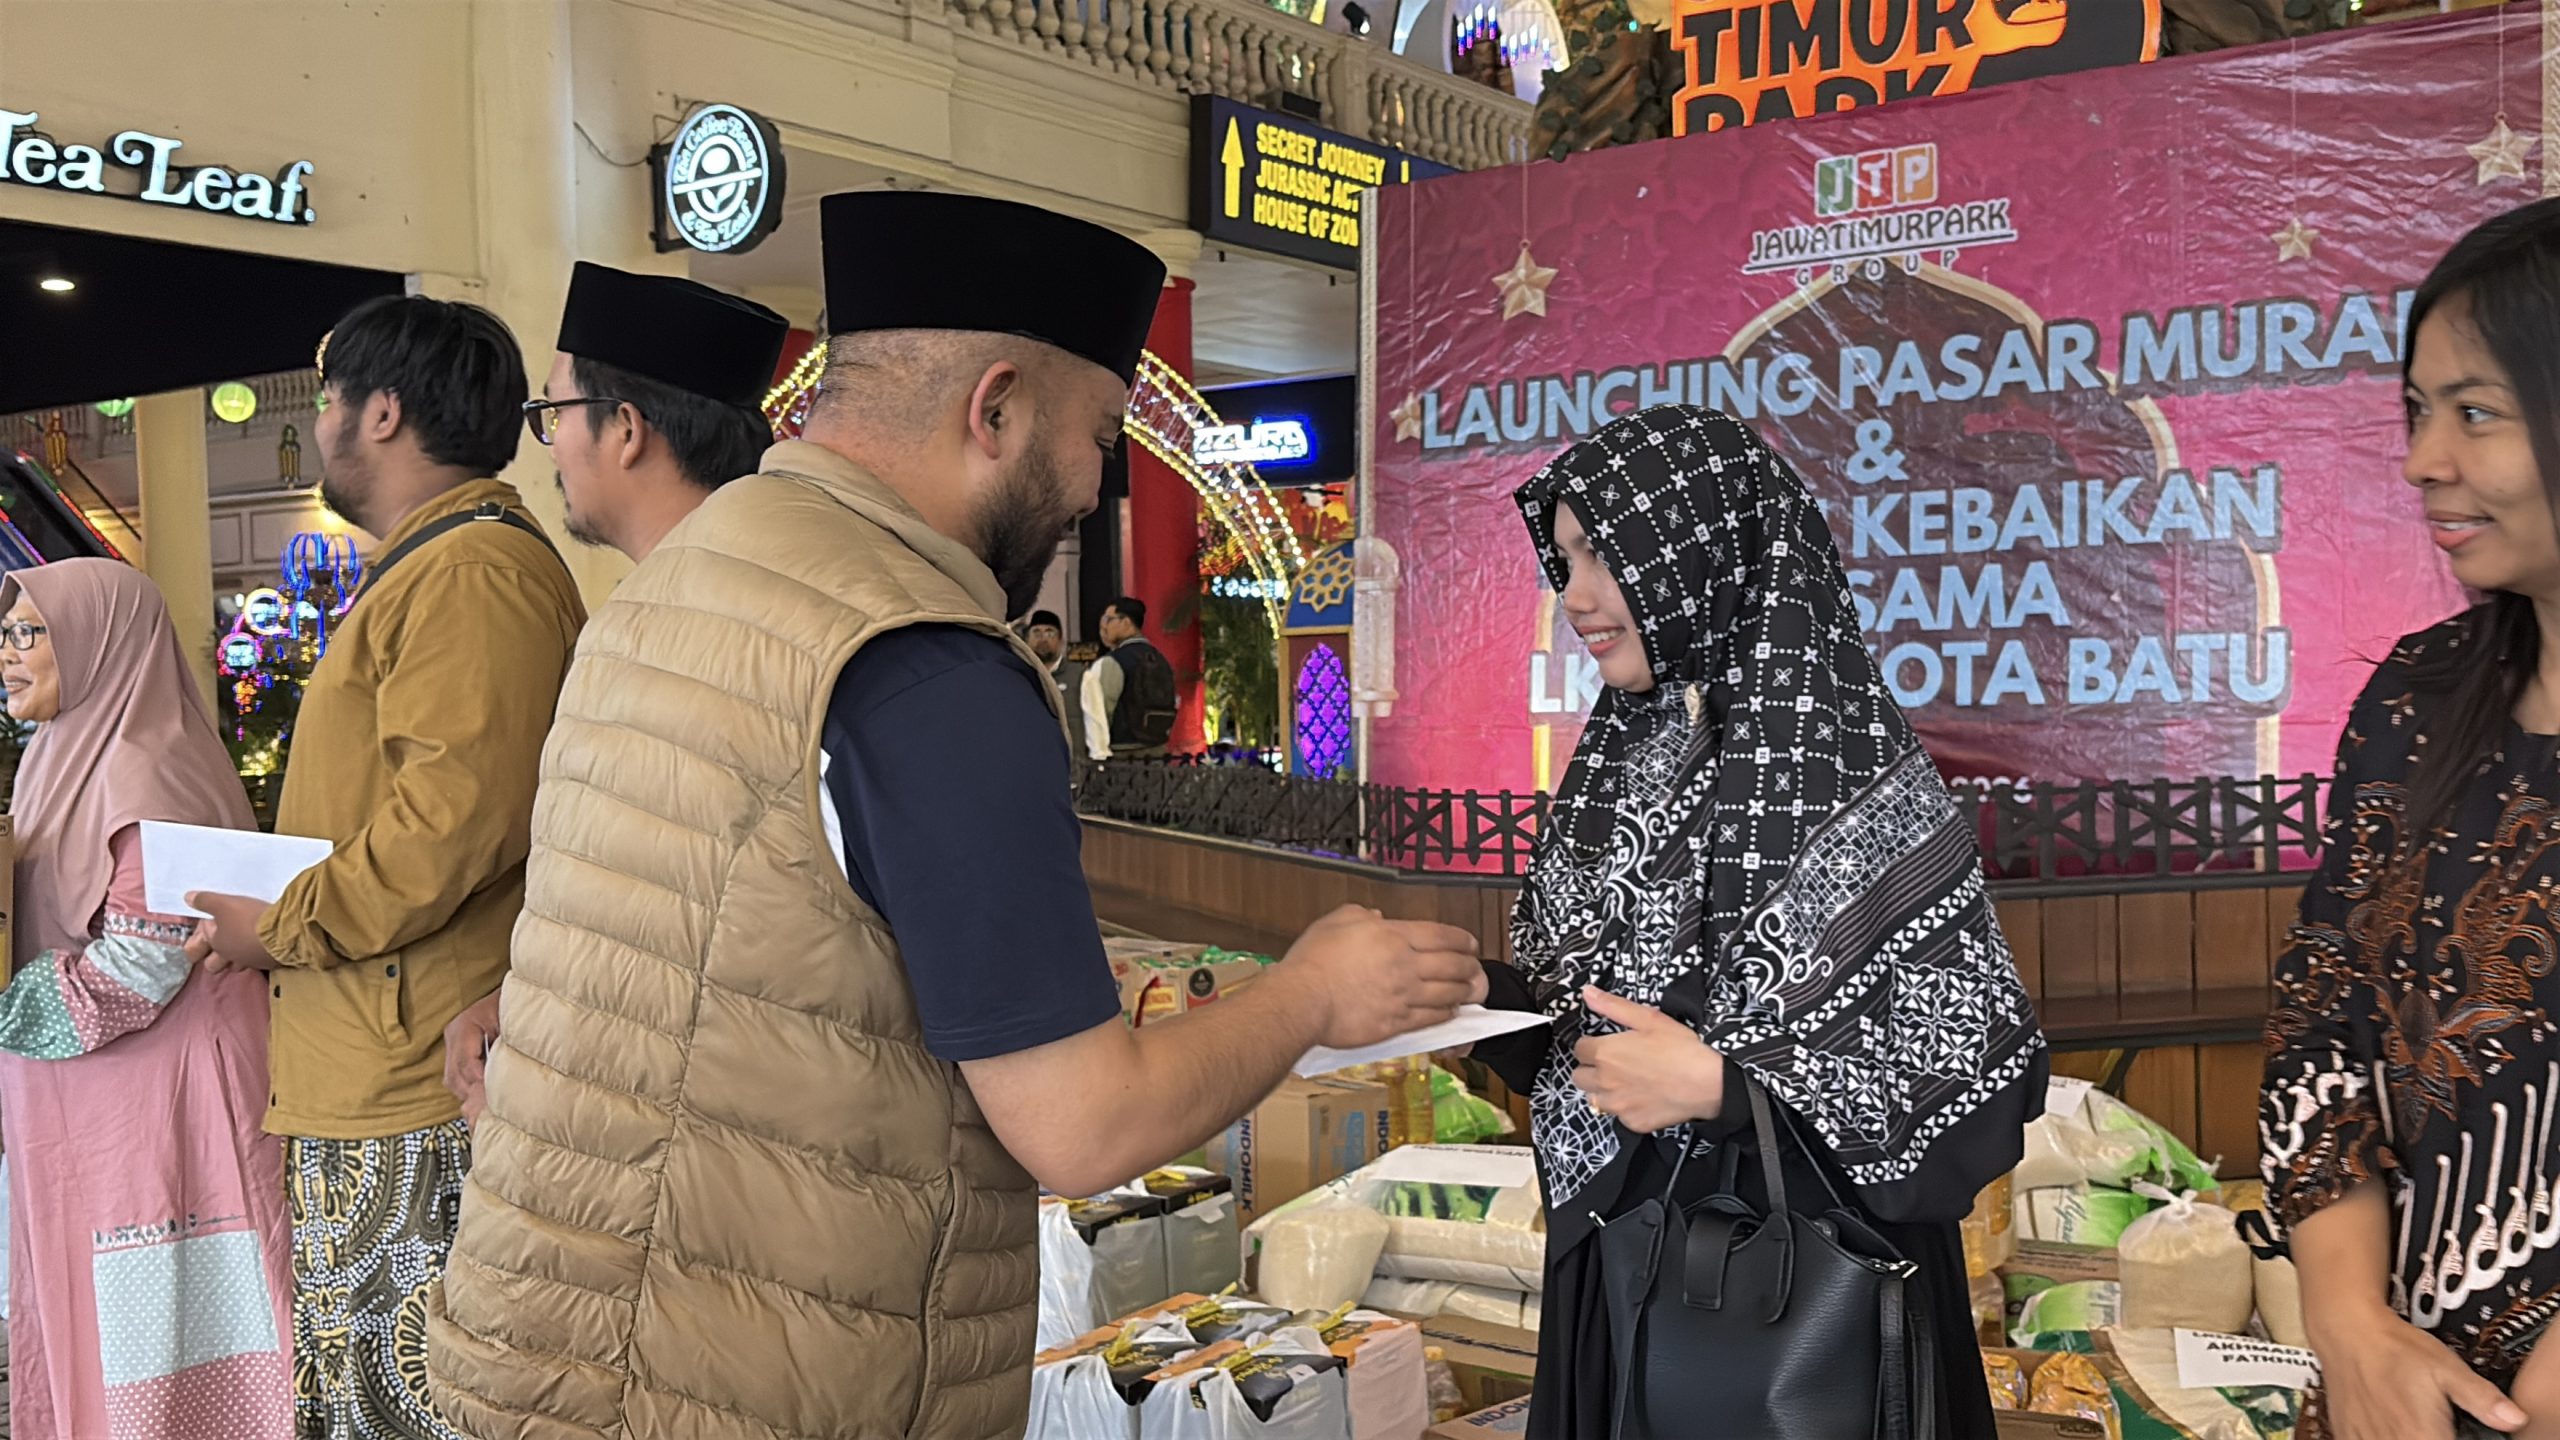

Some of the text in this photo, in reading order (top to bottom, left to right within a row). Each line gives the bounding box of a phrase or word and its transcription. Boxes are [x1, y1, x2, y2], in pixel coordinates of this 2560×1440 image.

[1682, 0, 1976, 87] TIMUR
[1256, 121, 1386, 186] SECRET JOURNEY
[1256, 159, 1331, 205] JURASSIC
[1820, 149, 1935, 210] JTP
[1253, 193, 1308, 235] HOUSE
[1308, 207, 1330, 239] OF
[1751, 200, 2012, 262] JAWATIMURPARK
[1796, 249, 1958, 287] GROUP
[1422, 290, 2417, 449] LAUNCHING PASAR MURA
[1846, 418, 1910, 485] &
[1852, 470, 2278, 559] KEBAIKAN
[1870, 638, 2047, 709] OTA
[2068, 630, 2288, 704] BATU
[1240, 1117, 1254, 1214] INDOMILK
